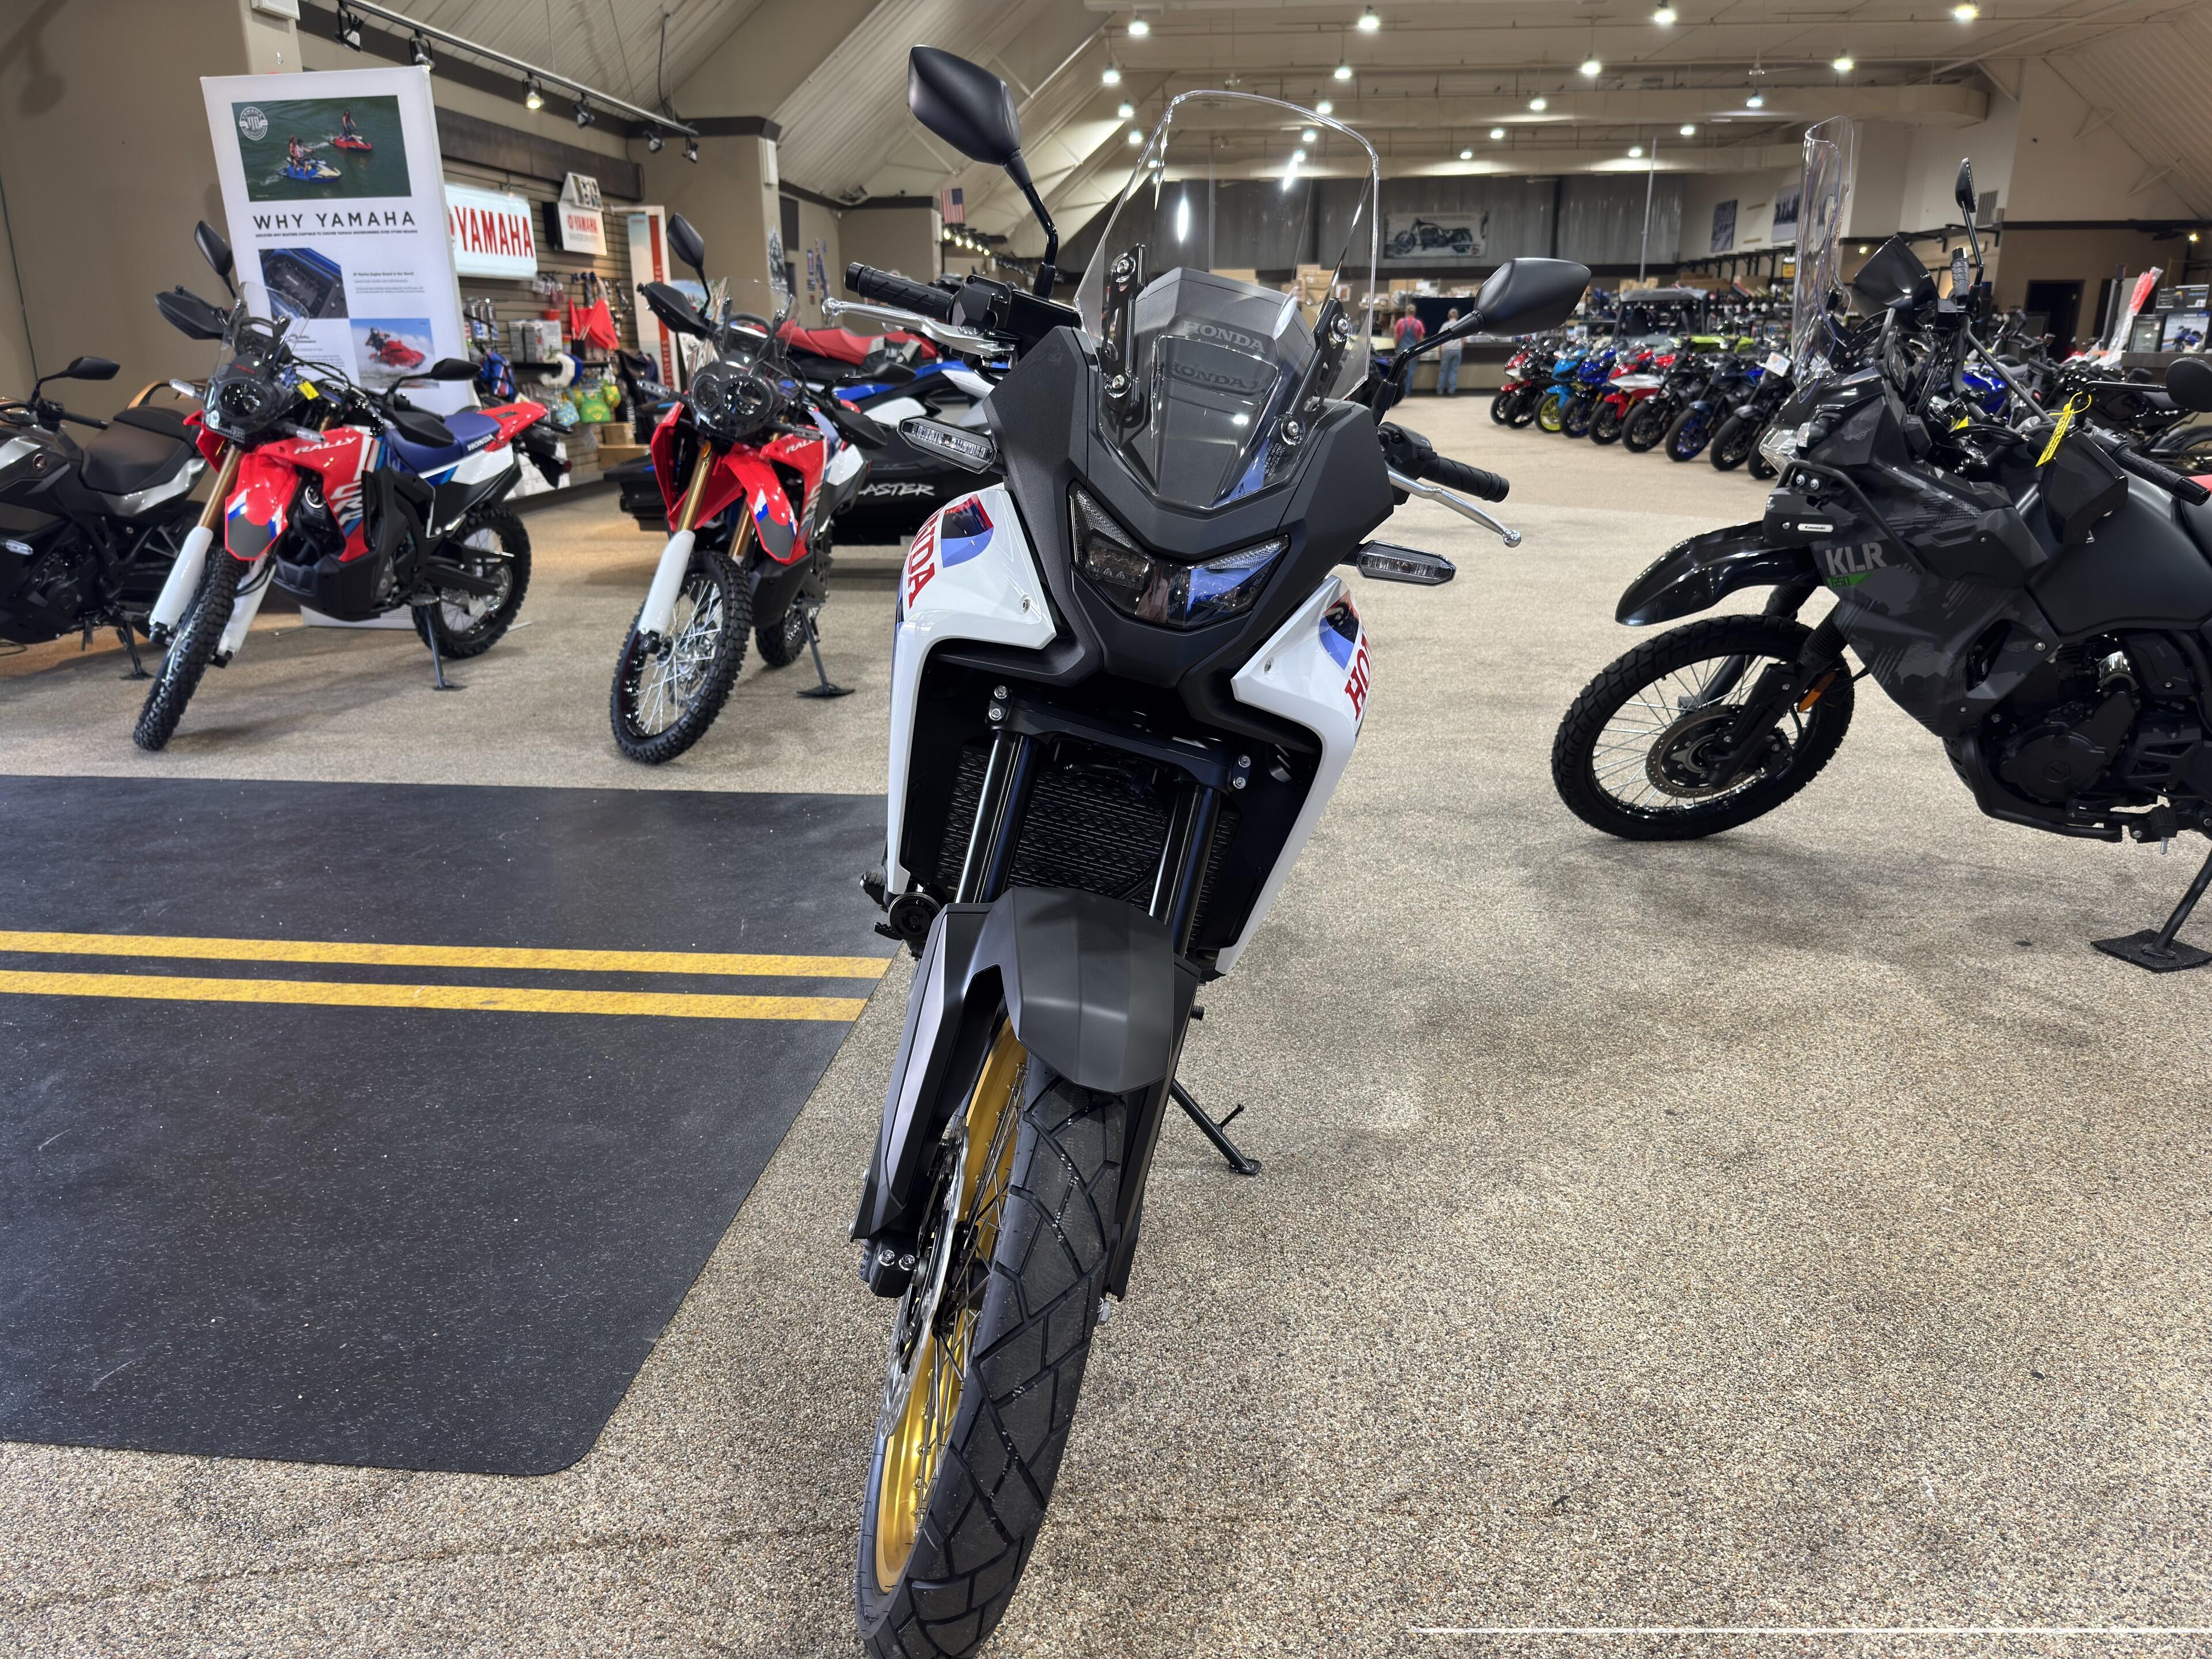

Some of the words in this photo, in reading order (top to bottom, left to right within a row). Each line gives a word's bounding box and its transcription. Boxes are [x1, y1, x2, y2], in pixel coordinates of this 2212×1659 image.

[253, 214, 304, 229] WHY
[316, 211, 415, 228] YAMAHA
[574, 214, 597, 233] YAMAHA
[454, 206, 534, 258] YAMAHA
[1183, 320, 1266, 354] HONDA
[236, 363, 256, 375] HONDA
[294, 437, 358, 454] RALLY
[467, 433, 494, 452] HONDA
[786, 440, 816, 454] RALL
[858, 482, 935, 496] ASTER
[1825, 542, 1888, 576] KLR
[1831, 576, 1850, 588] 650
